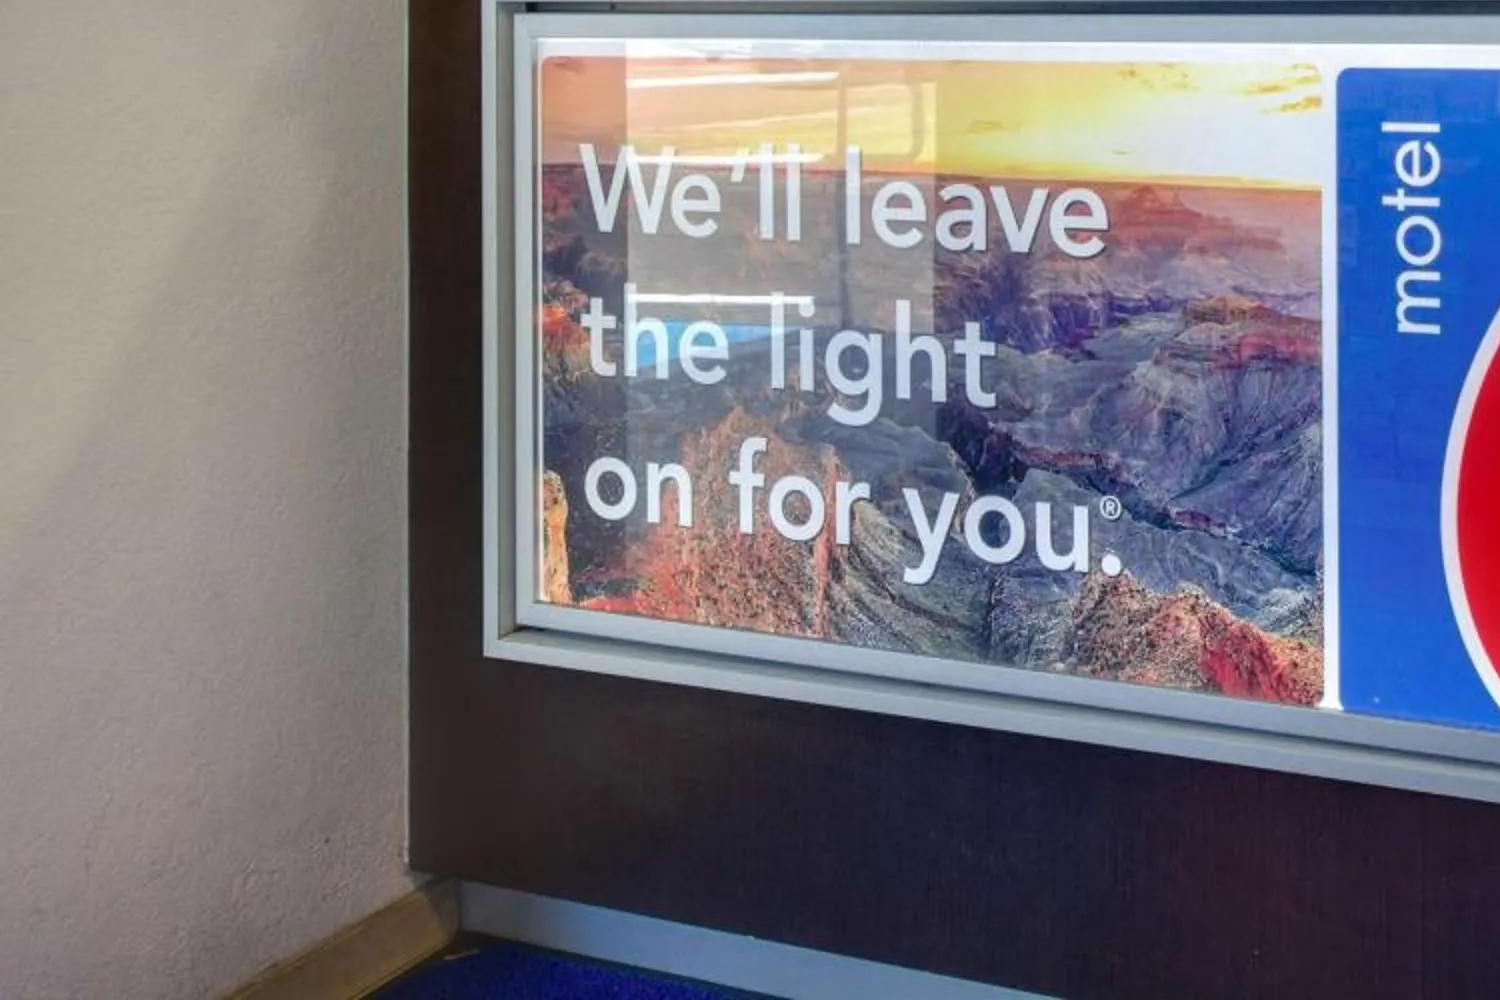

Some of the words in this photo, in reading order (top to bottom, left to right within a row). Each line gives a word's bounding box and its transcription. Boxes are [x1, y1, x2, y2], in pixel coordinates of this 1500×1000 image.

[579, 143, 802, 242] We'll
[845, 144, 1109, 258] leave
[1380, 120, 1442, 335] motel
[580, 282, 730, 385] the
[770, 291, 997, 427] light
[584, 456, 693, 528] on
[728, 437, 871, 546] for
